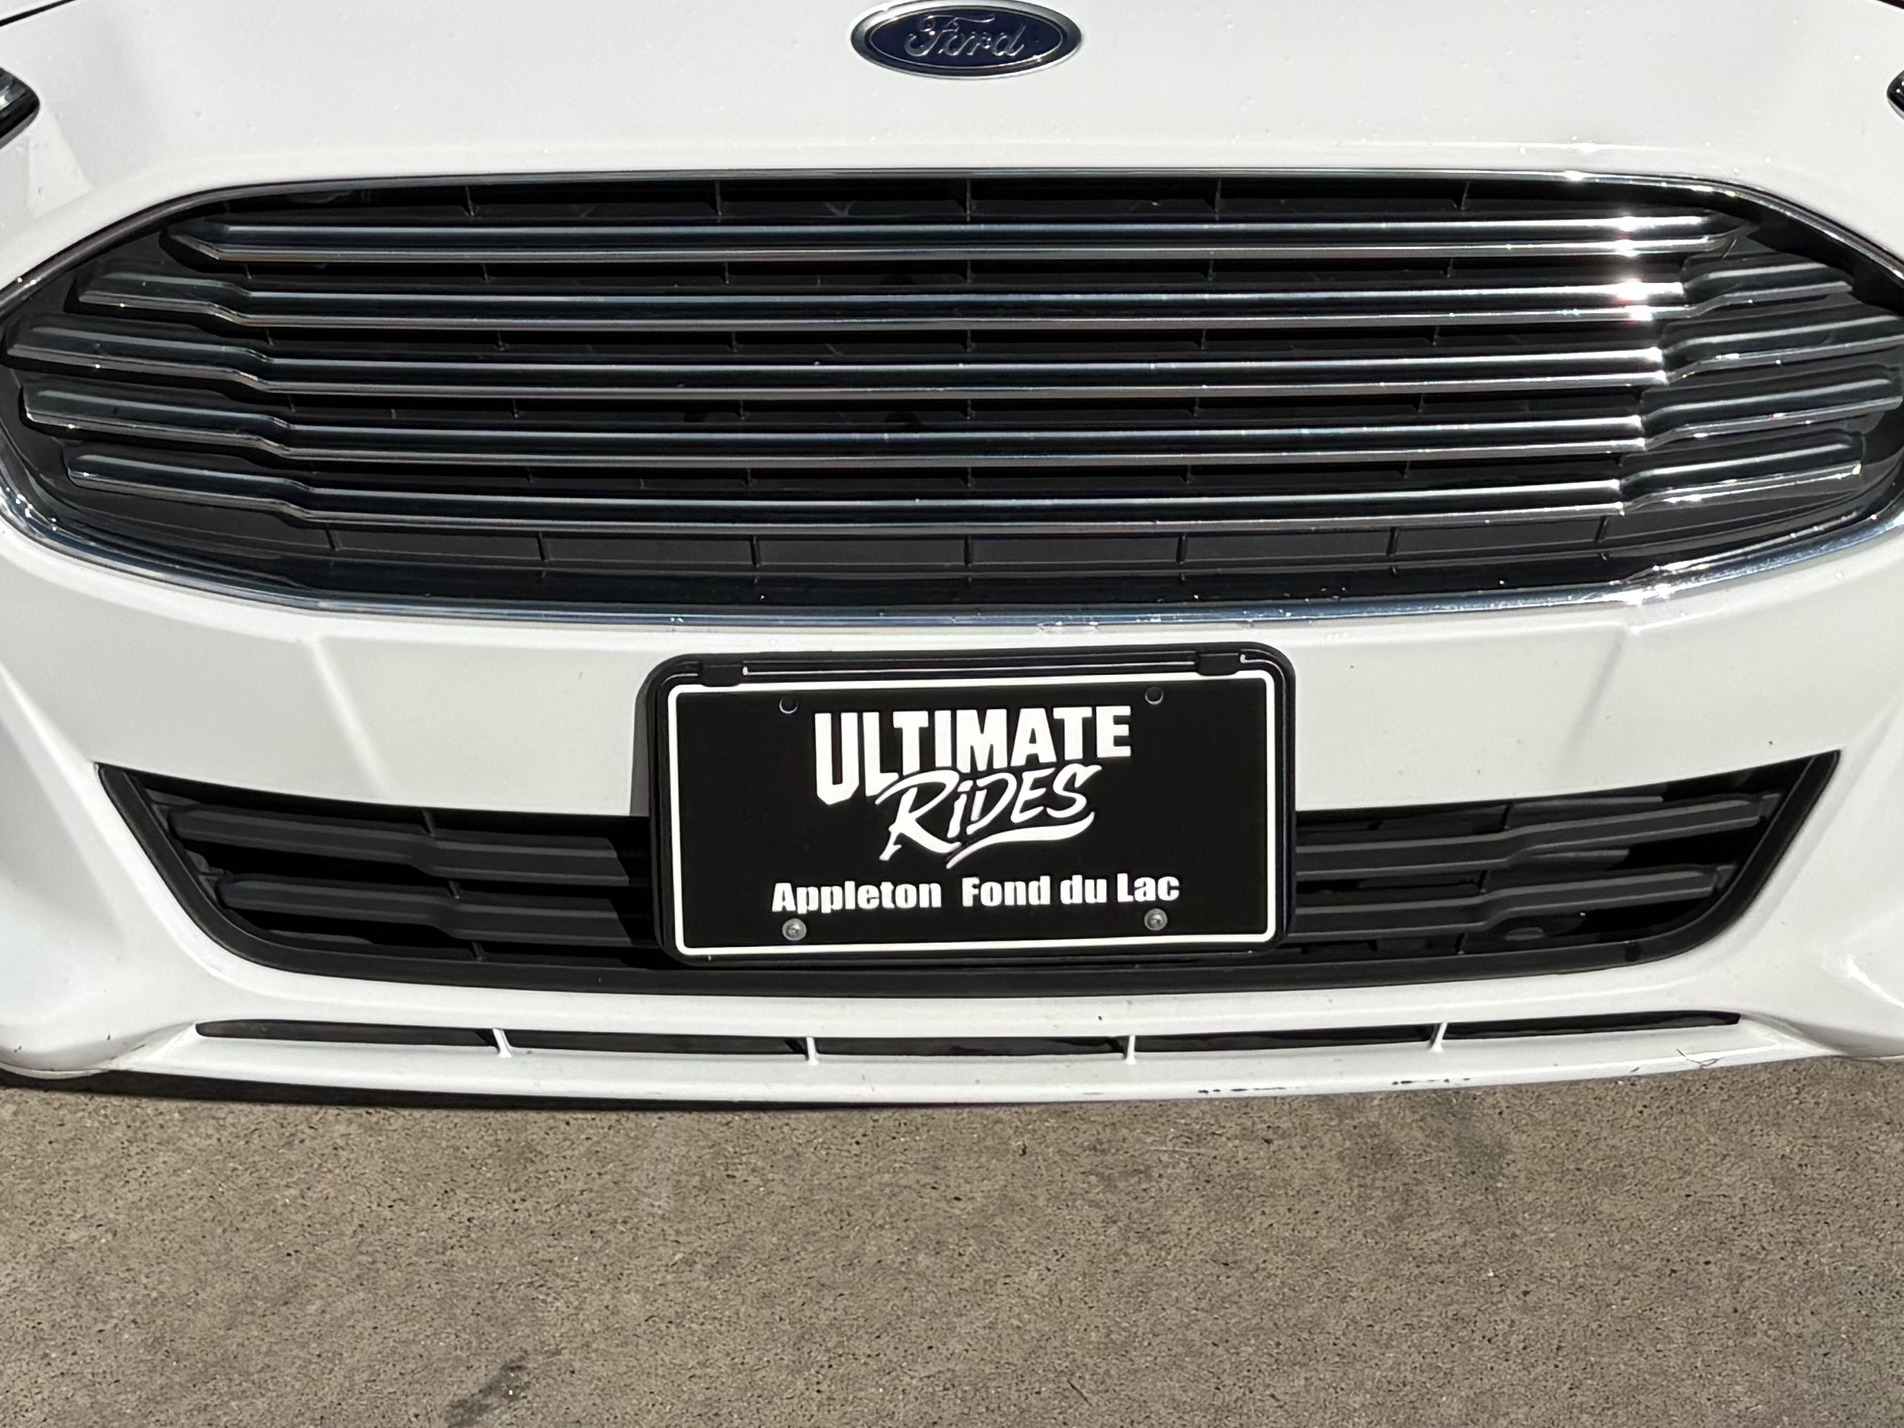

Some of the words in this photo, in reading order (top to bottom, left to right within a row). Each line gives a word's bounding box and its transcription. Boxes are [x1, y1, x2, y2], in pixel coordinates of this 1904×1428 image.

[904, 14, 1027, 57] Ford
[813, 704, 1133, 807] ULTIMATE
[771, 878, 943, 914] Appleton
[961, 876, 1052, 907] Fond
[1060, 874, 1108, 904] du
[1116, 871, 1181, 903] Lac
